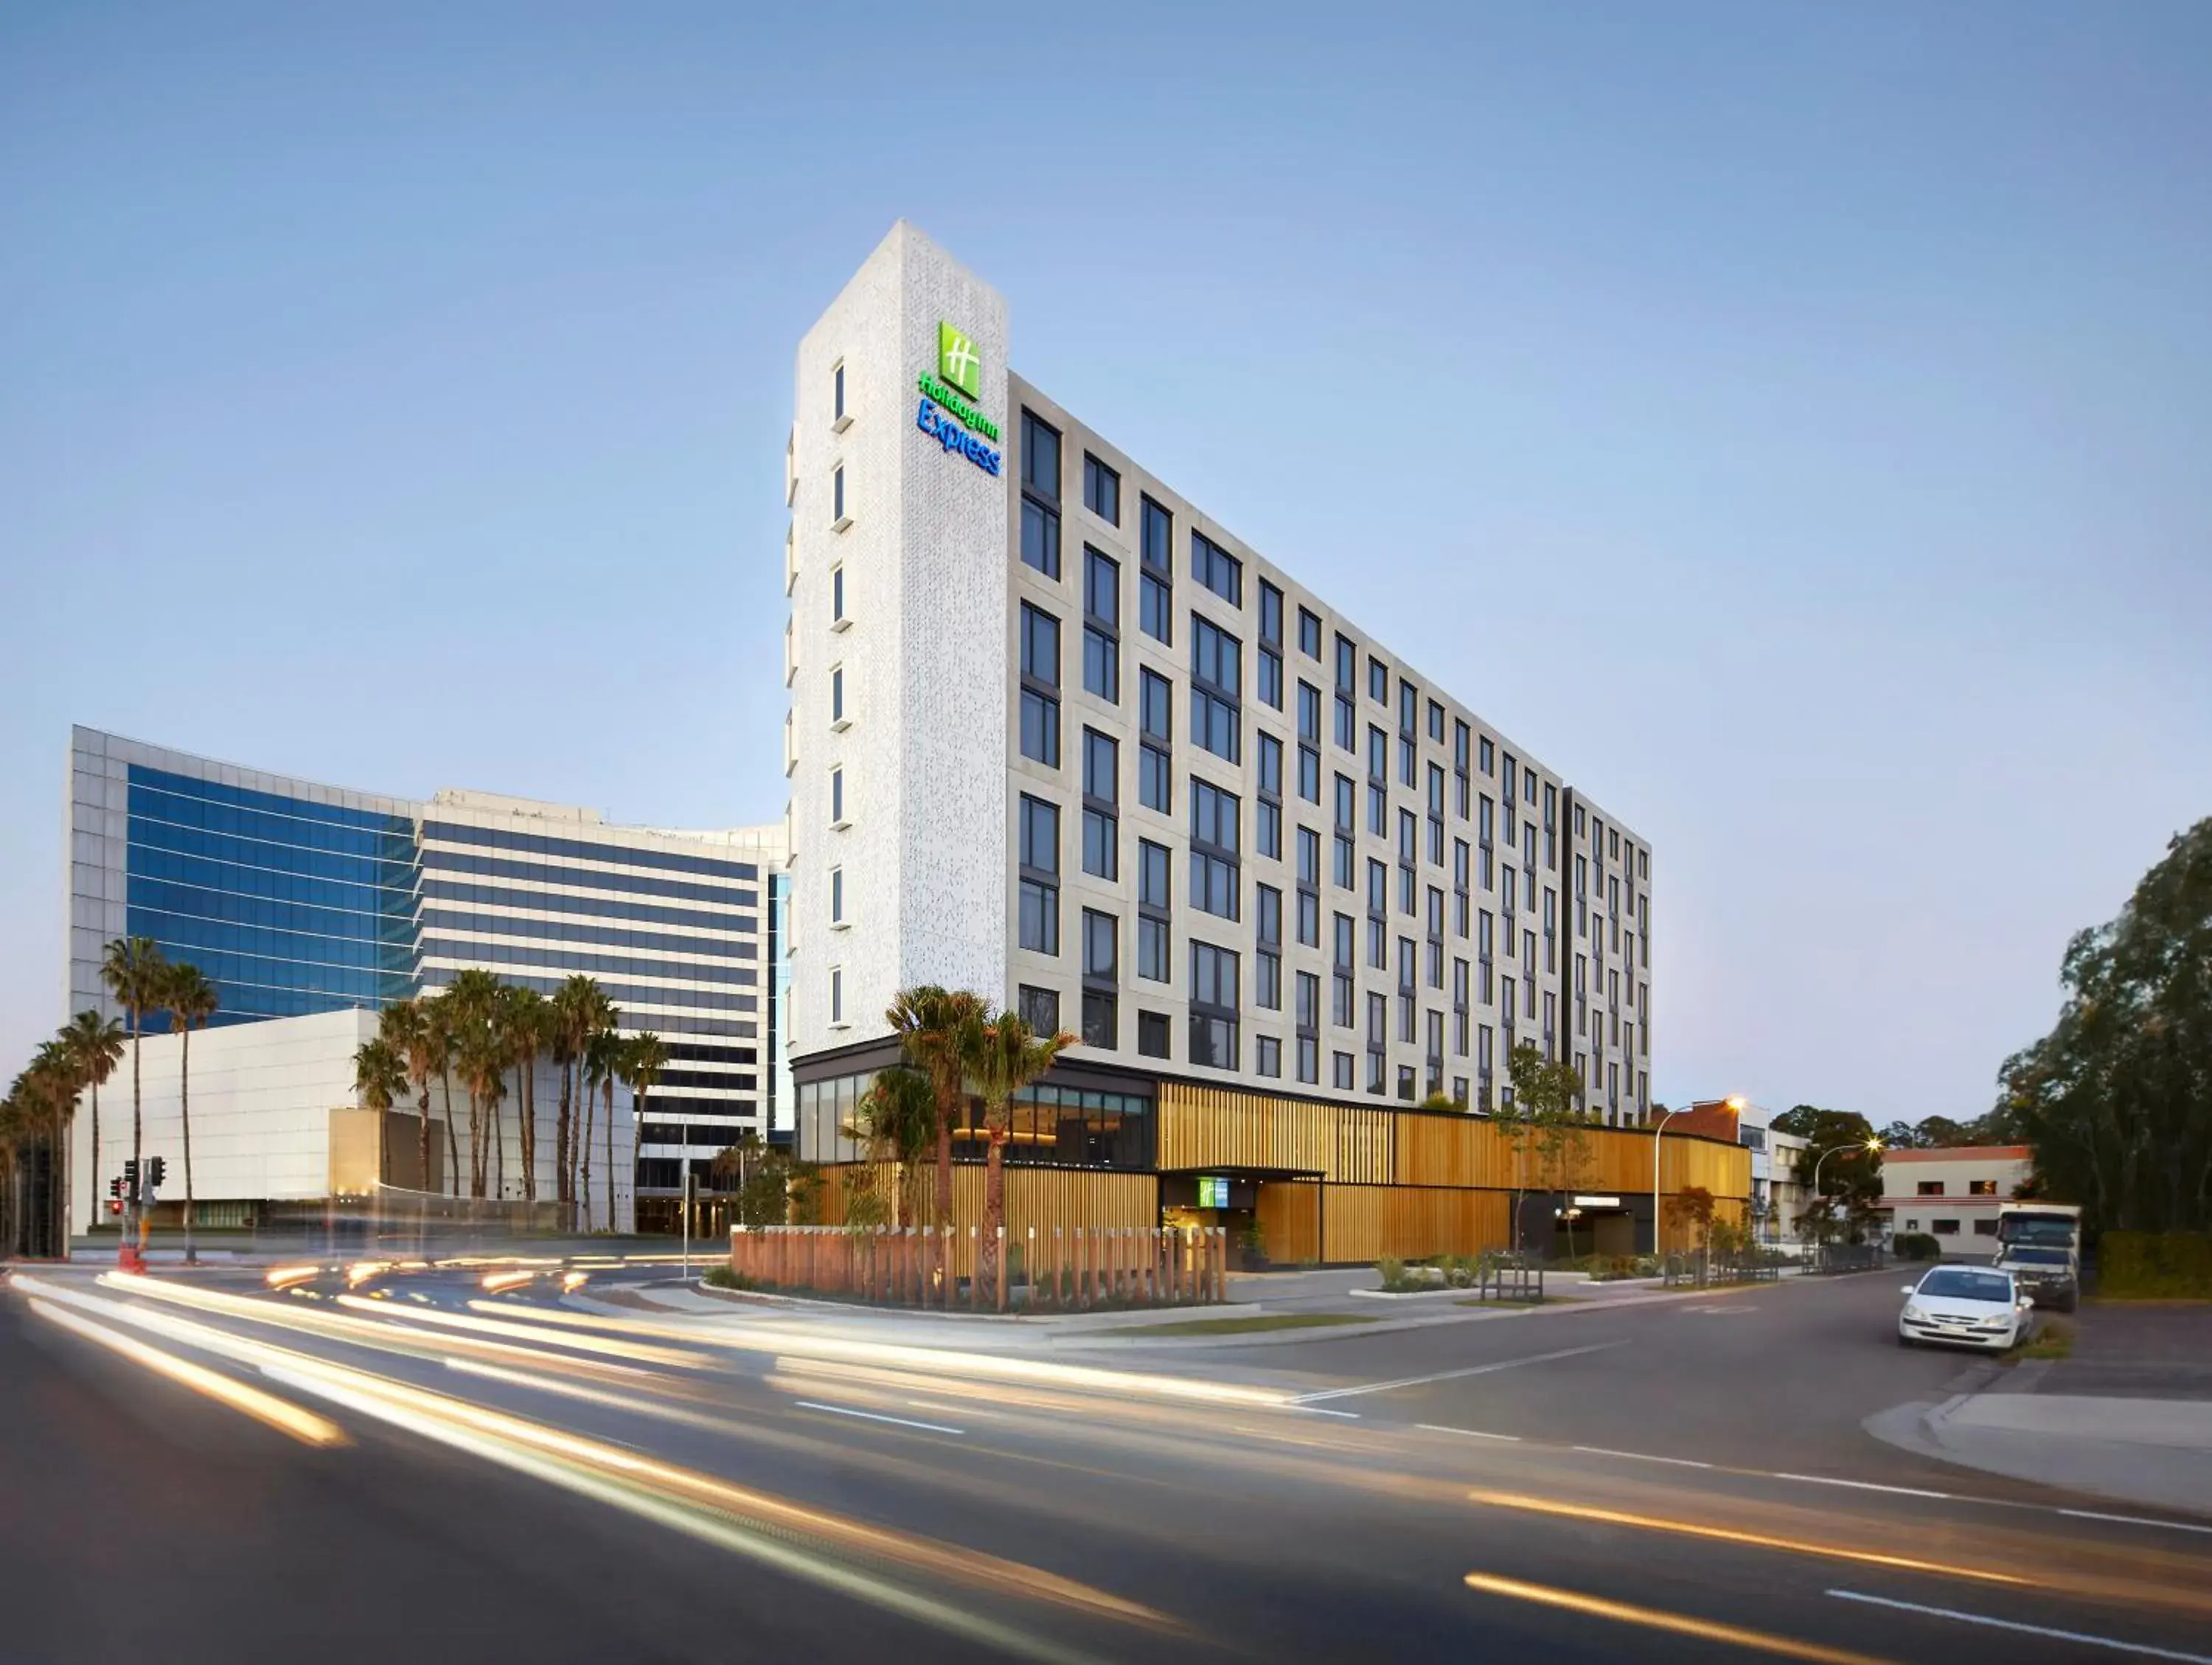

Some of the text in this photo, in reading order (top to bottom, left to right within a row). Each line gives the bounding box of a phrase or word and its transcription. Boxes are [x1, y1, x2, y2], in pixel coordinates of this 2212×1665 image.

[917, 398, 1001, 477] Express
[919, 371, 1000, 442] Holiday Inn
